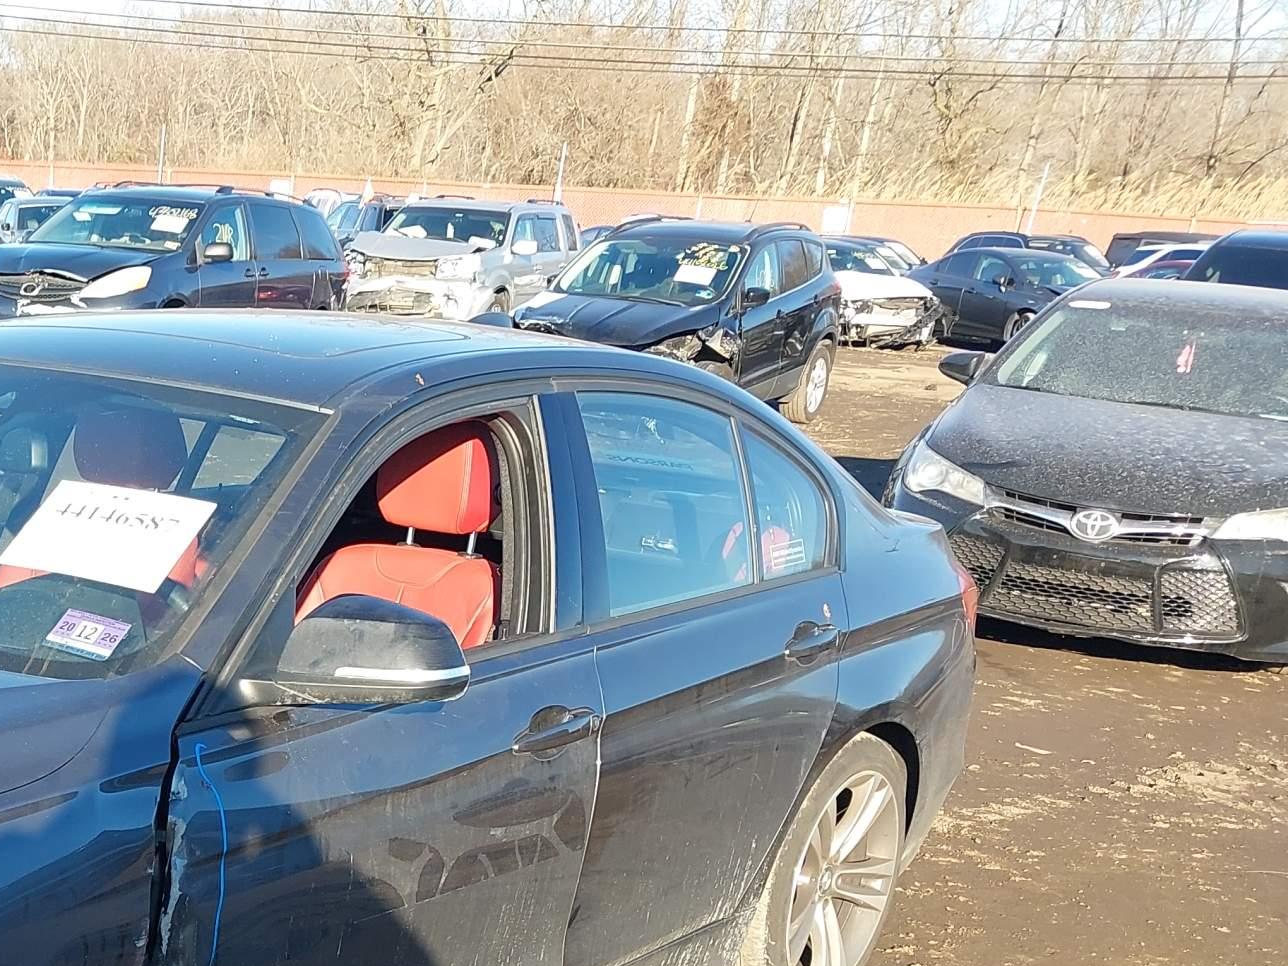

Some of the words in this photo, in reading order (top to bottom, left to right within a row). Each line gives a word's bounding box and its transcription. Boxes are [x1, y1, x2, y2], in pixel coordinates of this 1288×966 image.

[59, 620, 76, 632] 20
[75, 624, 98, 640] 12
[100, 632, 118, 644] 26
